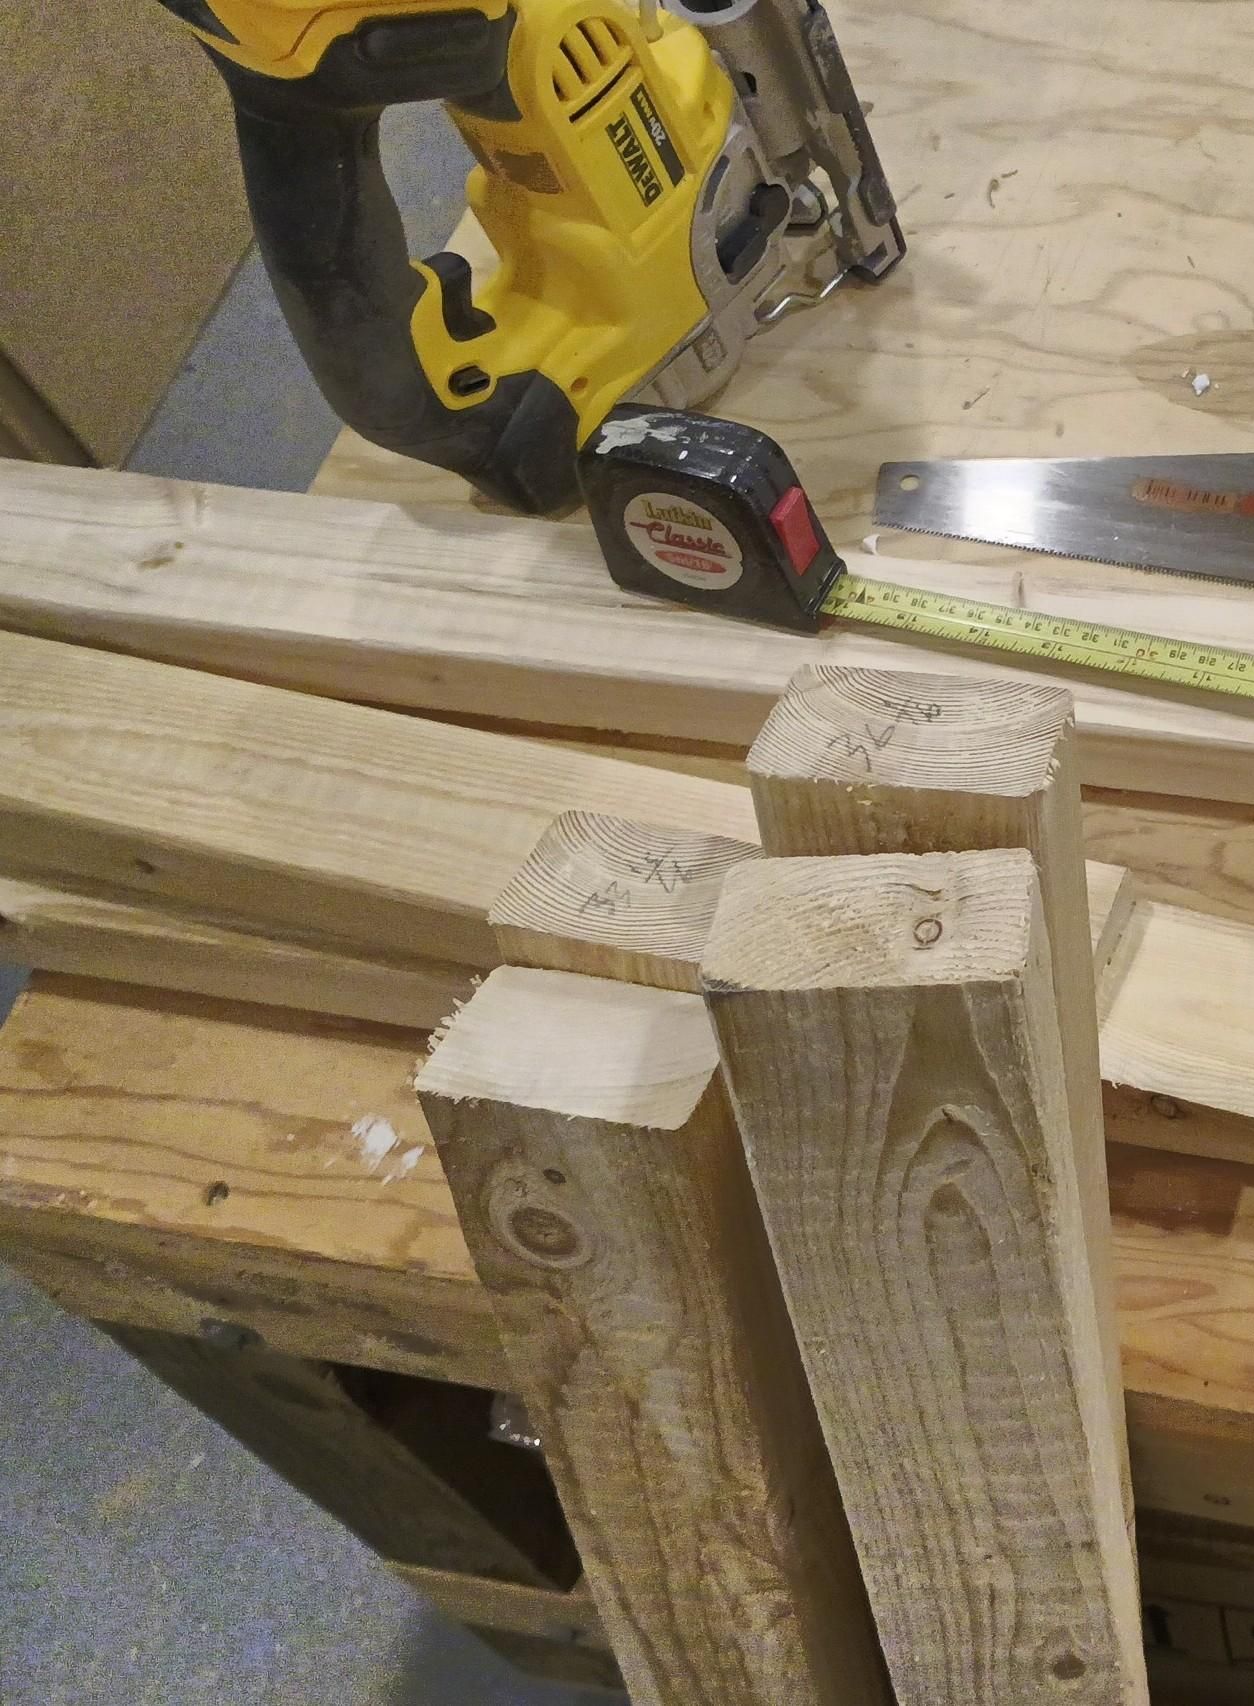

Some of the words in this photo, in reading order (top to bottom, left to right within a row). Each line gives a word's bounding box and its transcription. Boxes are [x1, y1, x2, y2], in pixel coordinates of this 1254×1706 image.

[630, 521, 732, 559] Classic
[882, 591, 900, 602] 39
[910, 597, 927, 608] 38
[938, 603, 956, 613] 37
[895, 612, 917, 622] 15
[967, 608, 985, 619] 36
[995, 614, 1013, 625] 35
[1024, 620, 1042, 631] 34
[1052, 626, 1070, 636] 33
[968, 626, 990, 637] 14
[1081, 632, 1099, 642] 32
[1041, 641, 1063, 652] 13
[1113, 638, 1128, 648] 31
[1168, 649, 1187, 660] 29
[1197, 654, 1216, 666] 28
[1227, 660, 1245, 671] 27
[1192, 670, 1212, 681] 11
